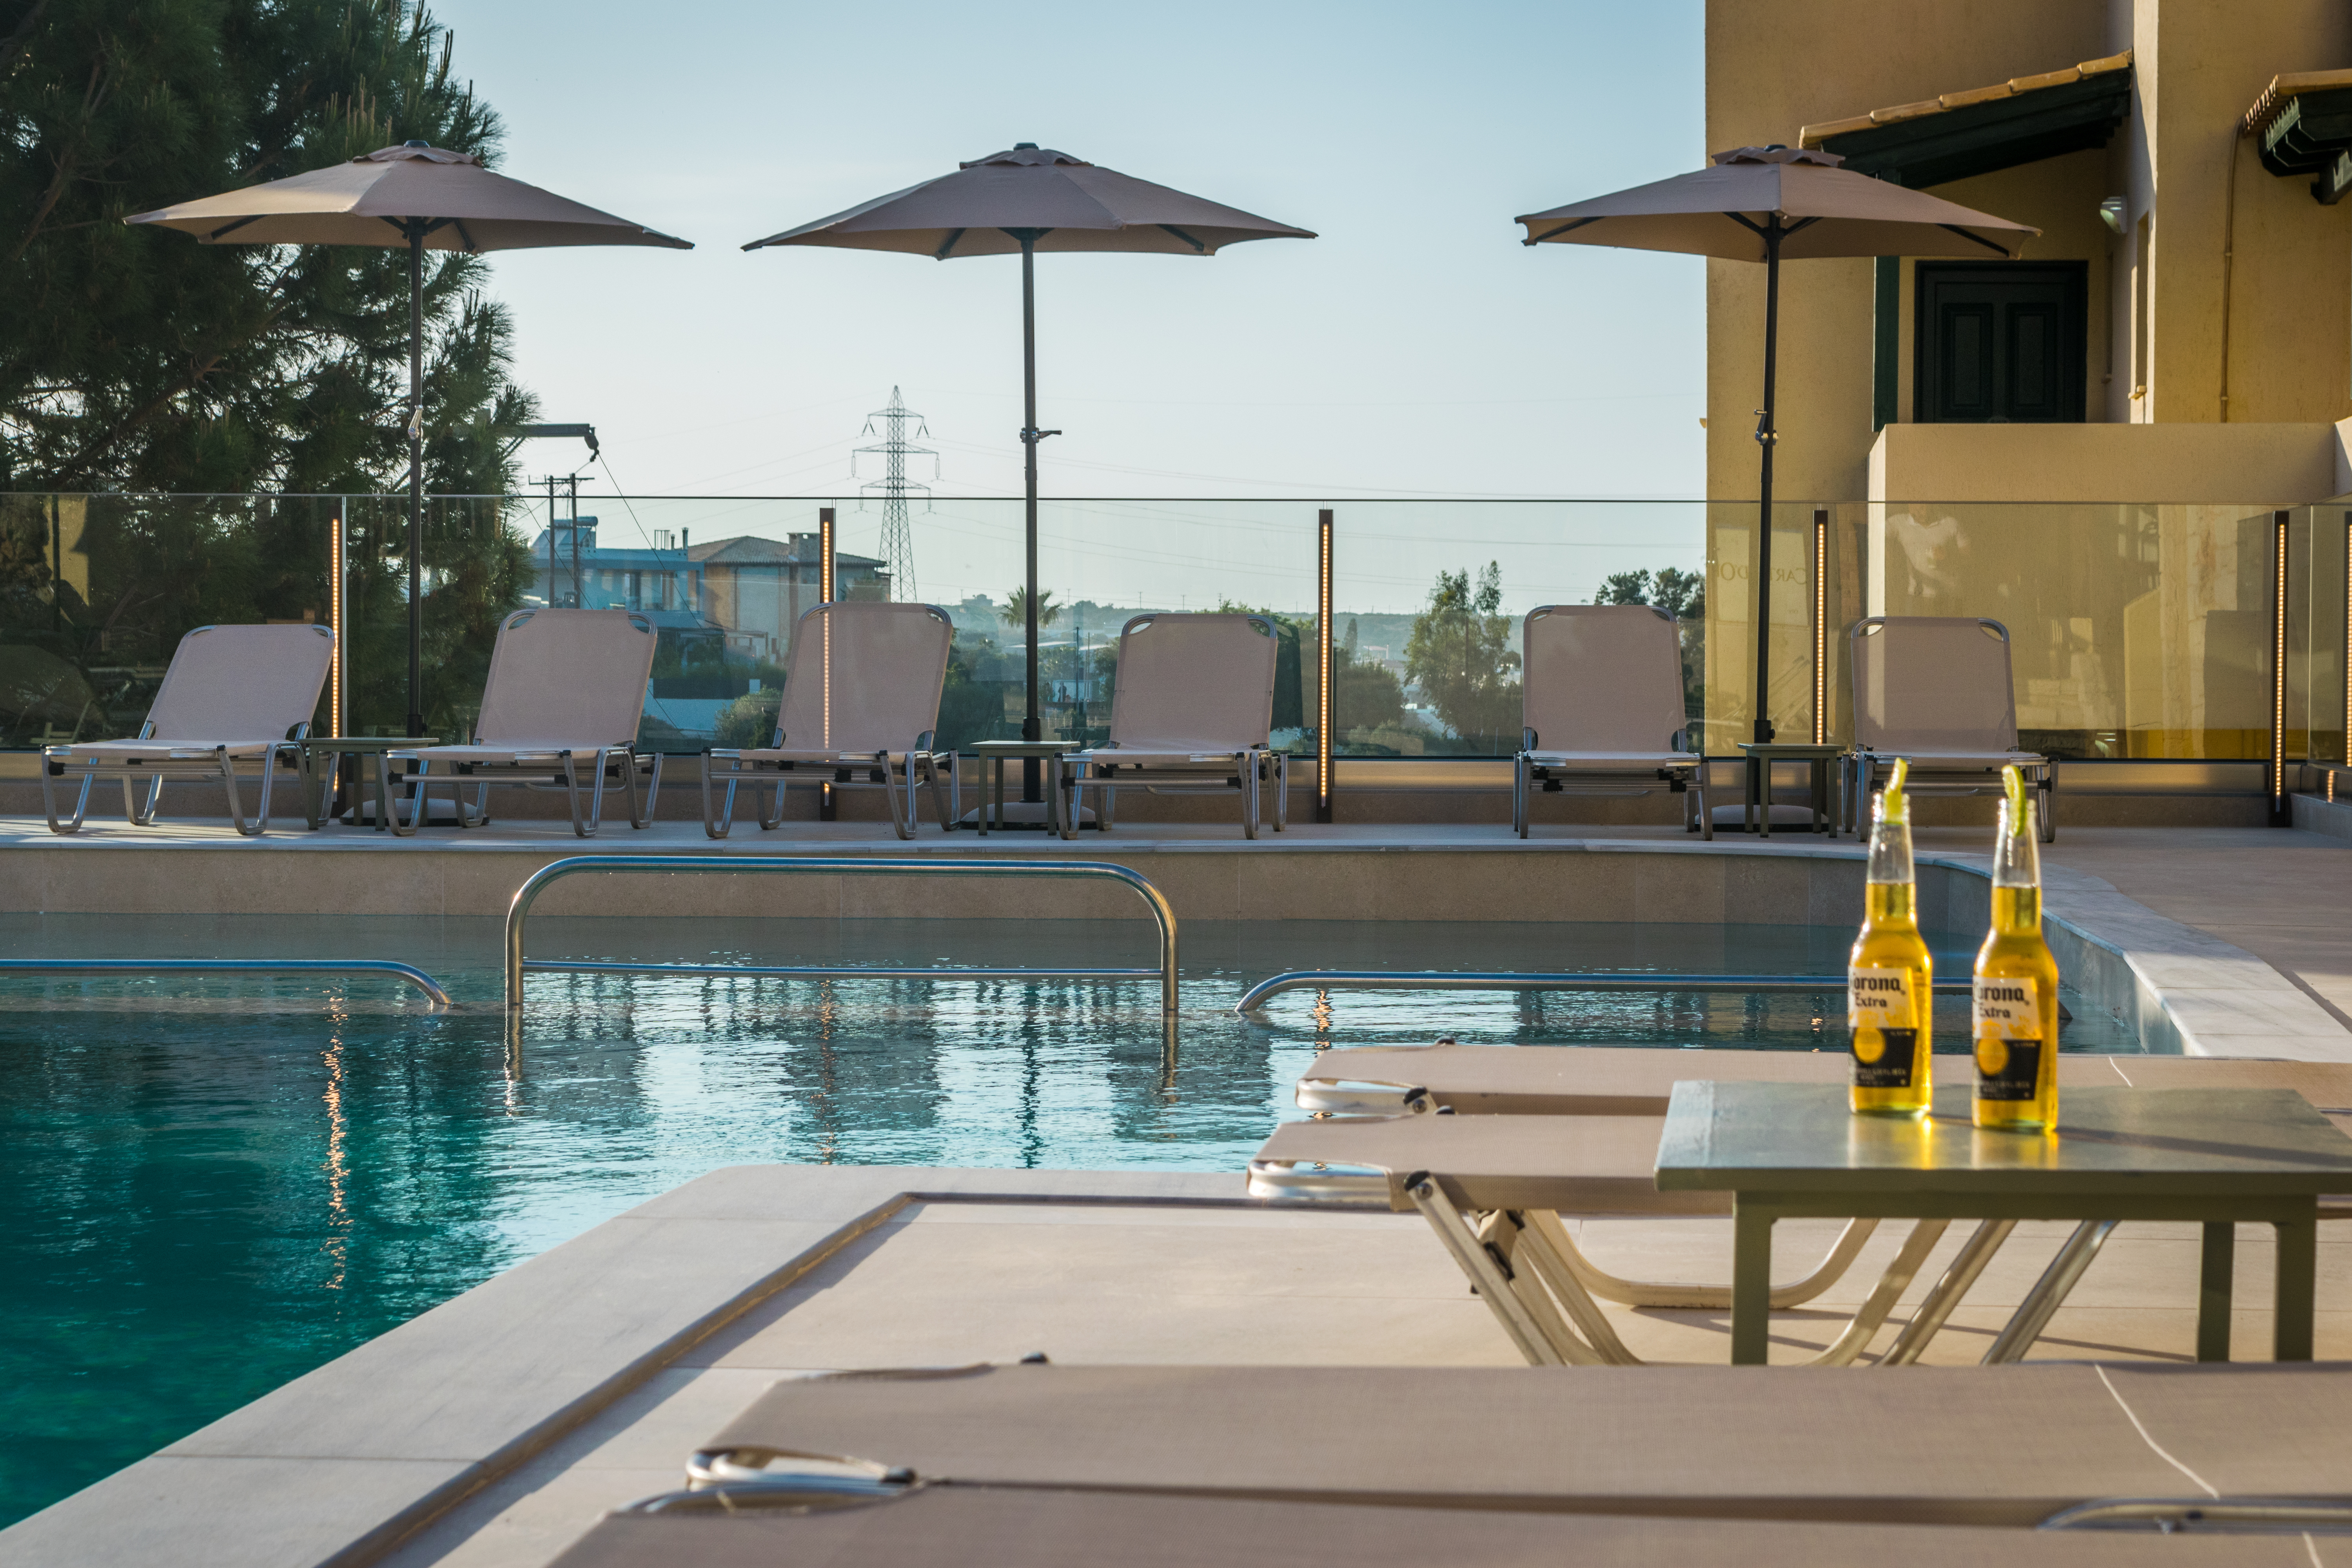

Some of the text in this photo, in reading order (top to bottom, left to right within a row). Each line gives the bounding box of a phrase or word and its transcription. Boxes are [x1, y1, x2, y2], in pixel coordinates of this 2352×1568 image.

[1850, 975, 1900, 991] orona
[1855, 992, 1887, 1007] Extra
[1979, 1002, 2011, 1018] Extra
